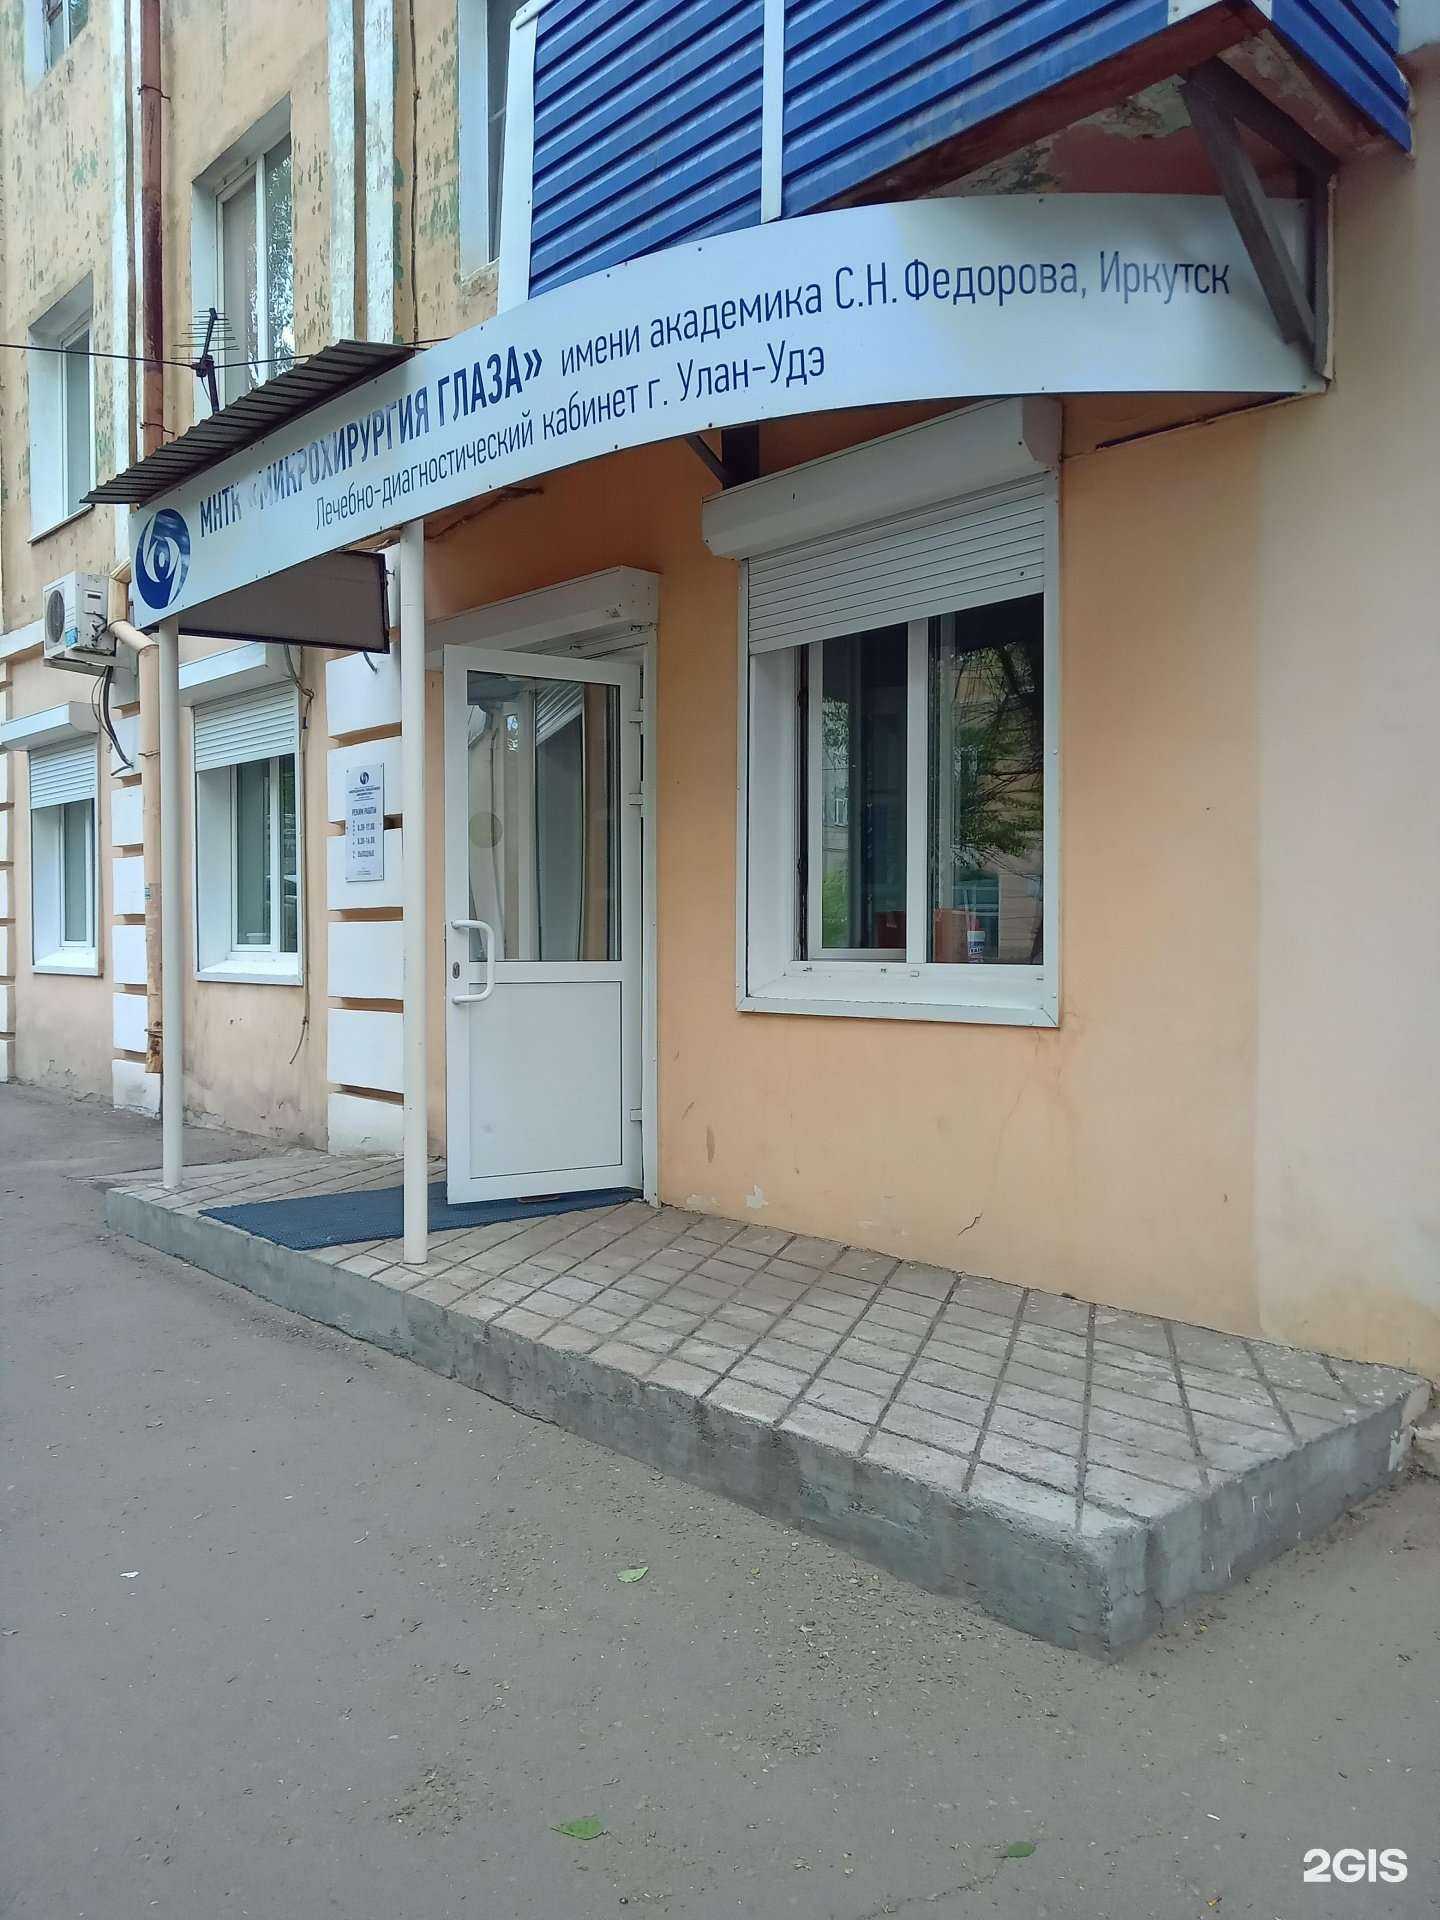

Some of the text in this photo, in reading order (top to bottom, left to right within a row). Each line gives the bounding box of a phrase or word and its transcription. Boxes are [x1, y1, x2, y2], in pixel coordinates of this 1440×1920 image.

[200, 481, 242, 537] МНТК
[437, 345, 543, 427] ГЛАЗА»
[561, 325, 640, 376] имени
[650, 283, 822, 349] академика
[1100, 250, 1230, 304] Иркутск
[316, 340, 825, 531] Лечебно-диагностический кабинет г. Улан-Удэ
